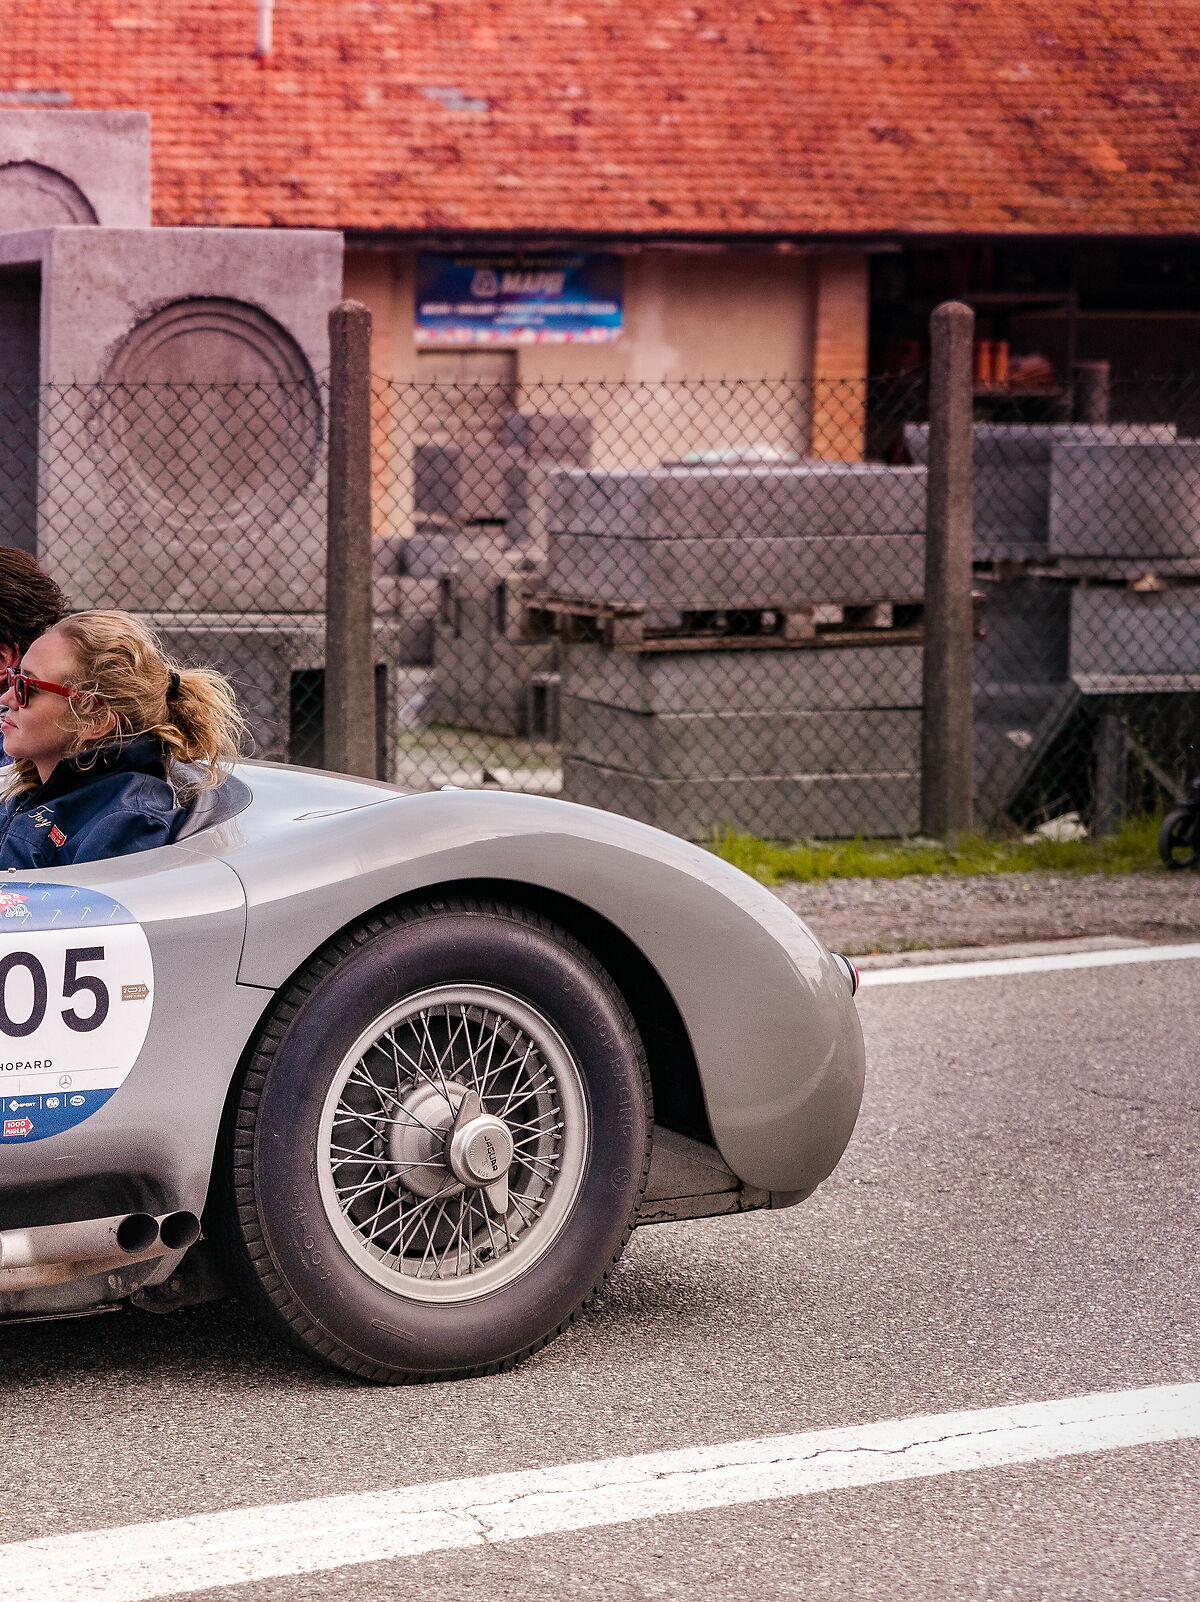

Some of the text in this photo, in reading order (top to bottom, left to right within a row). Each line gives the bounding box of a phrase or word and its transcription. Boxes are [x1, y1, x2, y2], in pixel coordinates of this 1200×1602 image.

[7, 1121, 27, 1129] 1000
[6, 1127, 28, 1136] MIGLIA
[484, 1135, 498, 1172] JAGUAR
